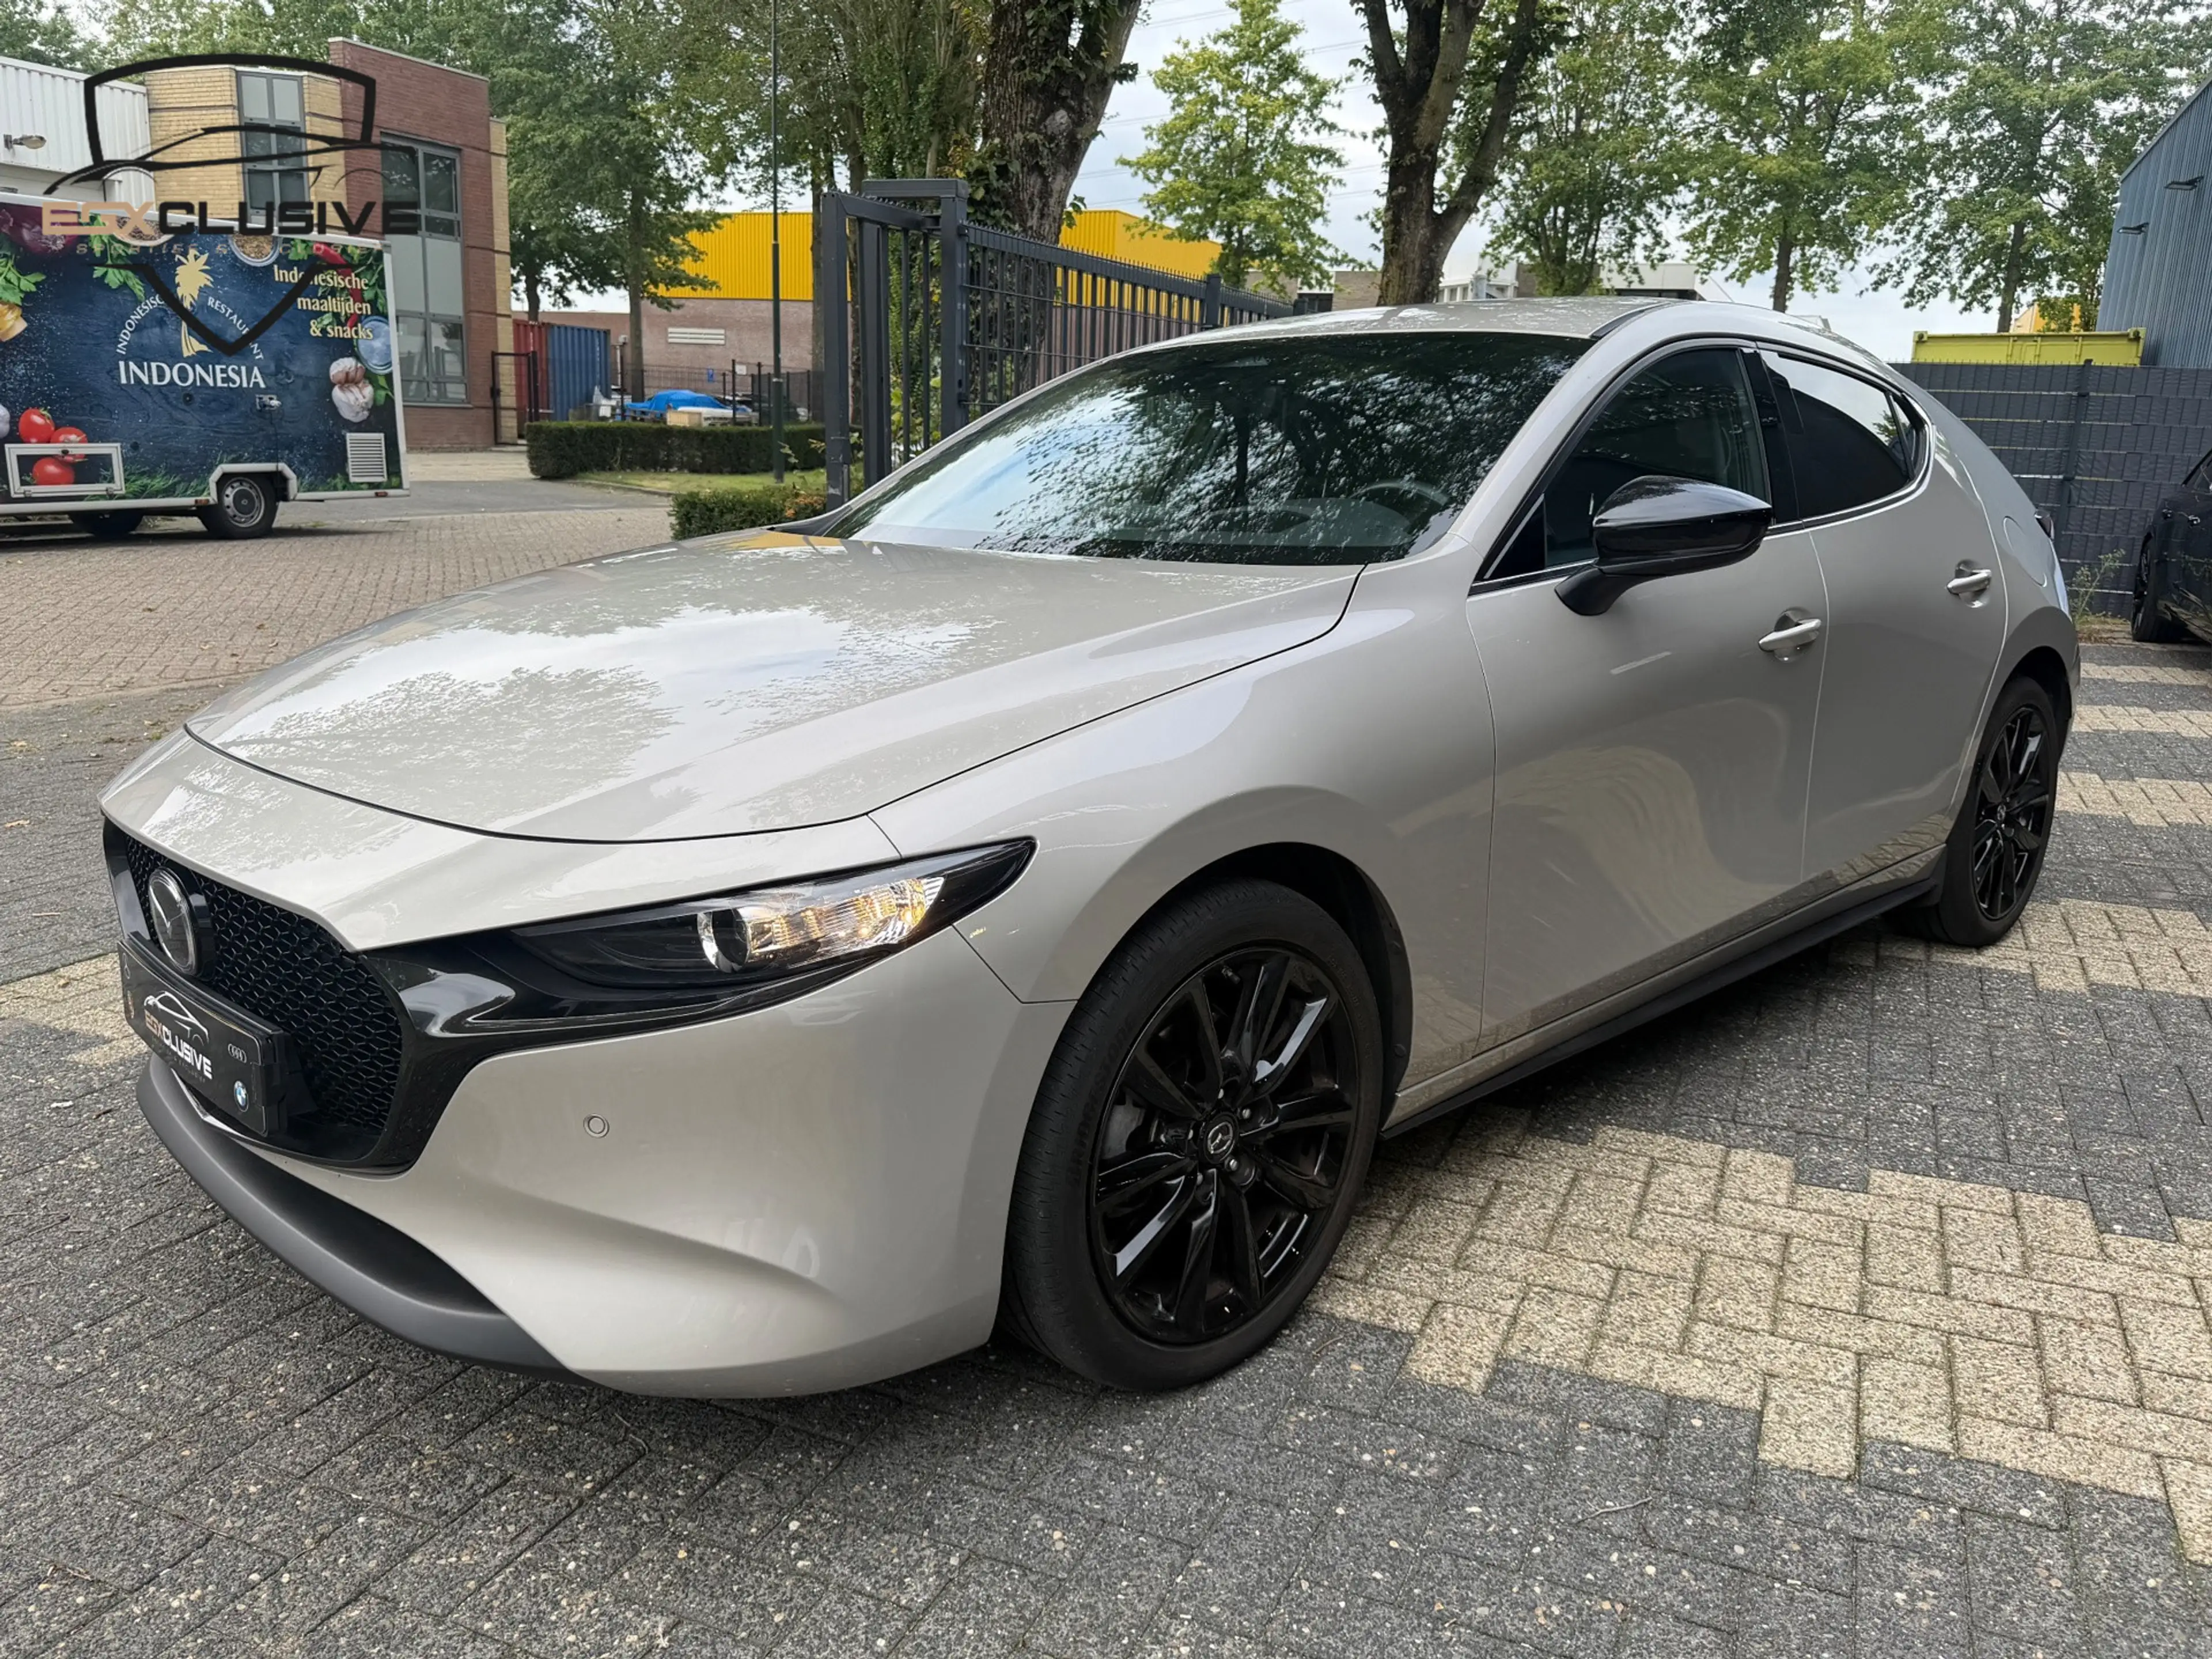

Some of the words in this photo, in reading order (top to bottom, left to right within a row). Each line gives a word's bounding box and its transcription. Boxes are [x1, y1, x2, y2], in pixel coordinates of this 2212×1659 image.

[297, 296, 372, 317] maaltijden
[116, 294, 165, 355] INDONESISC
[207, 297, 264, 360] RESTAUNT
[309, 320, 323, 337] &
[327, 323, 374, 340] snacks
[119, 361, 266, 388] INDONESIA
